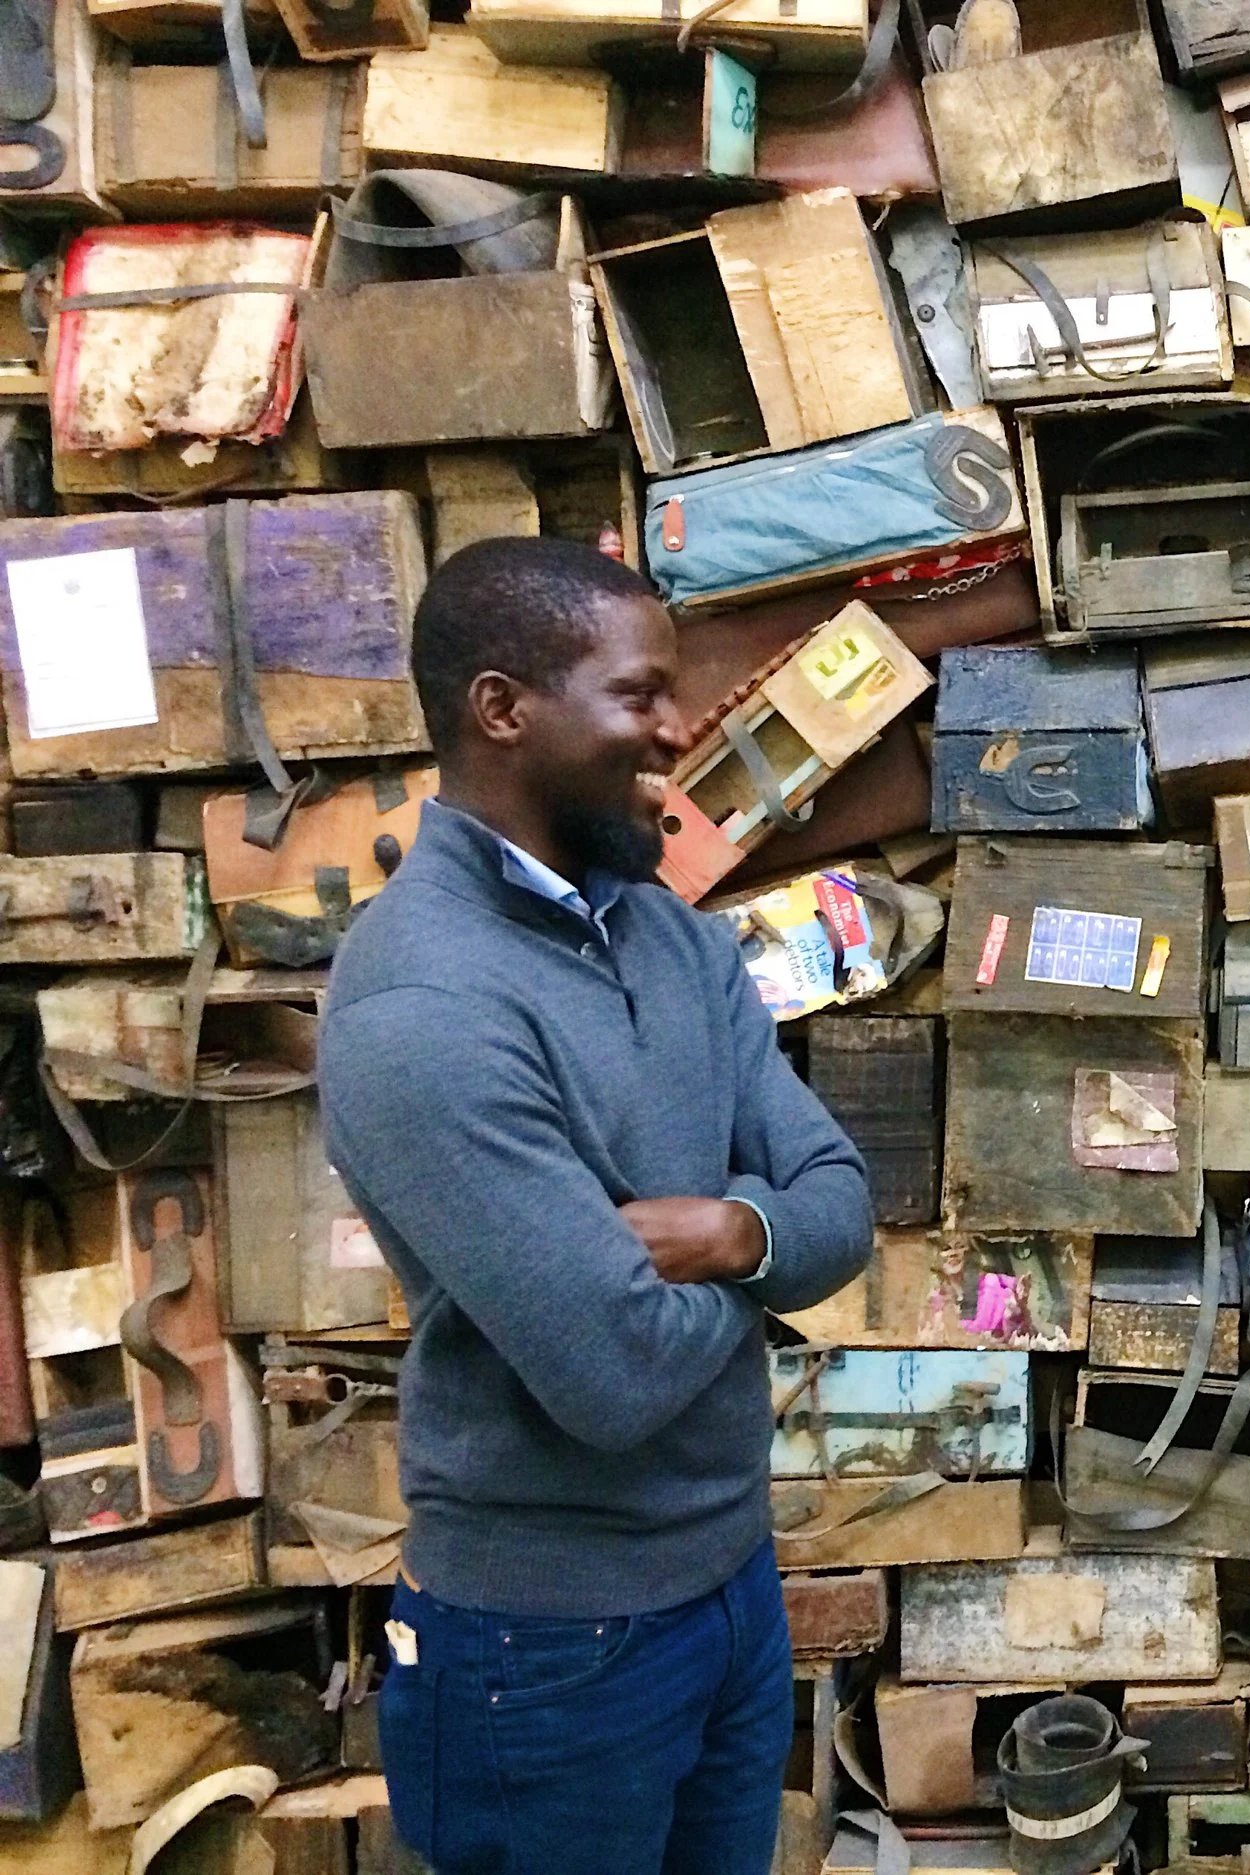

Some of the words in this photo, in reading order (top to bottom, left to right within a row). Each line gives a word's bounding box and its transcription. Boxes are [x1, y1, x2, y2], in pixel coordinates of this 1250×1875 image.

[822, 880, 850, 945] Economist
[839, 899, 853, 922] The
[797, 939, 810, 955] of
[812, 939, 825, 951] A
[784, 939, 806, 992] debtors
[803, 956, 818, 984] two
[816, 951, 831, 977] tale
